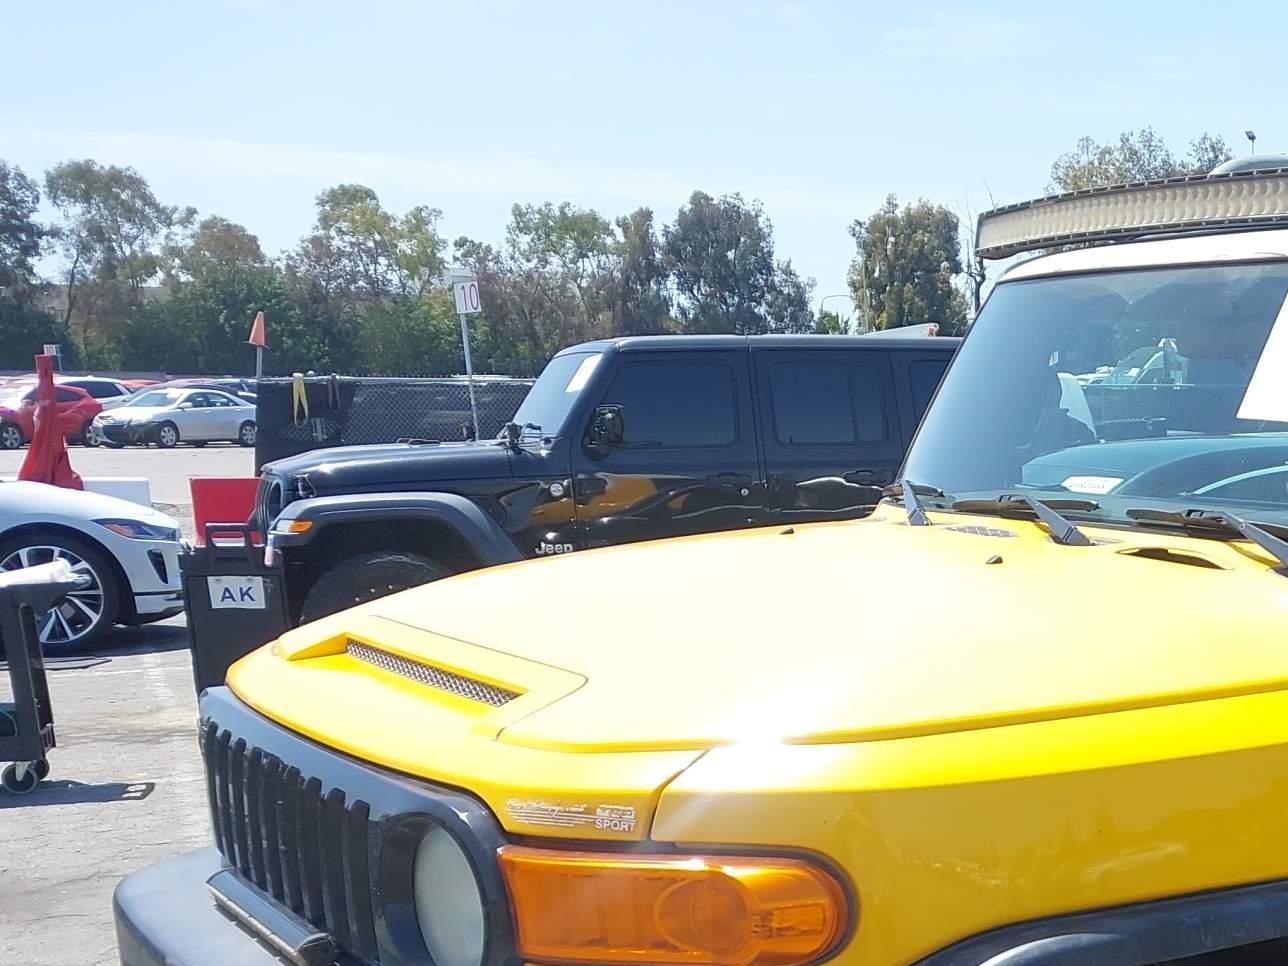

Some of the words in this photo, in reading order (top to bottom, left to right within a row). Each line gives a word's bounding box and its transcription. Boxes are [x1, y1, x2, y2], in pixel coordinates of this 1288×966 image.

[460, 283, 479, 311] 10
[535, 541, 574, 555] Jeep
[220, 586, 256, 602] AK
[594, 818, 635, 833] SPORT
